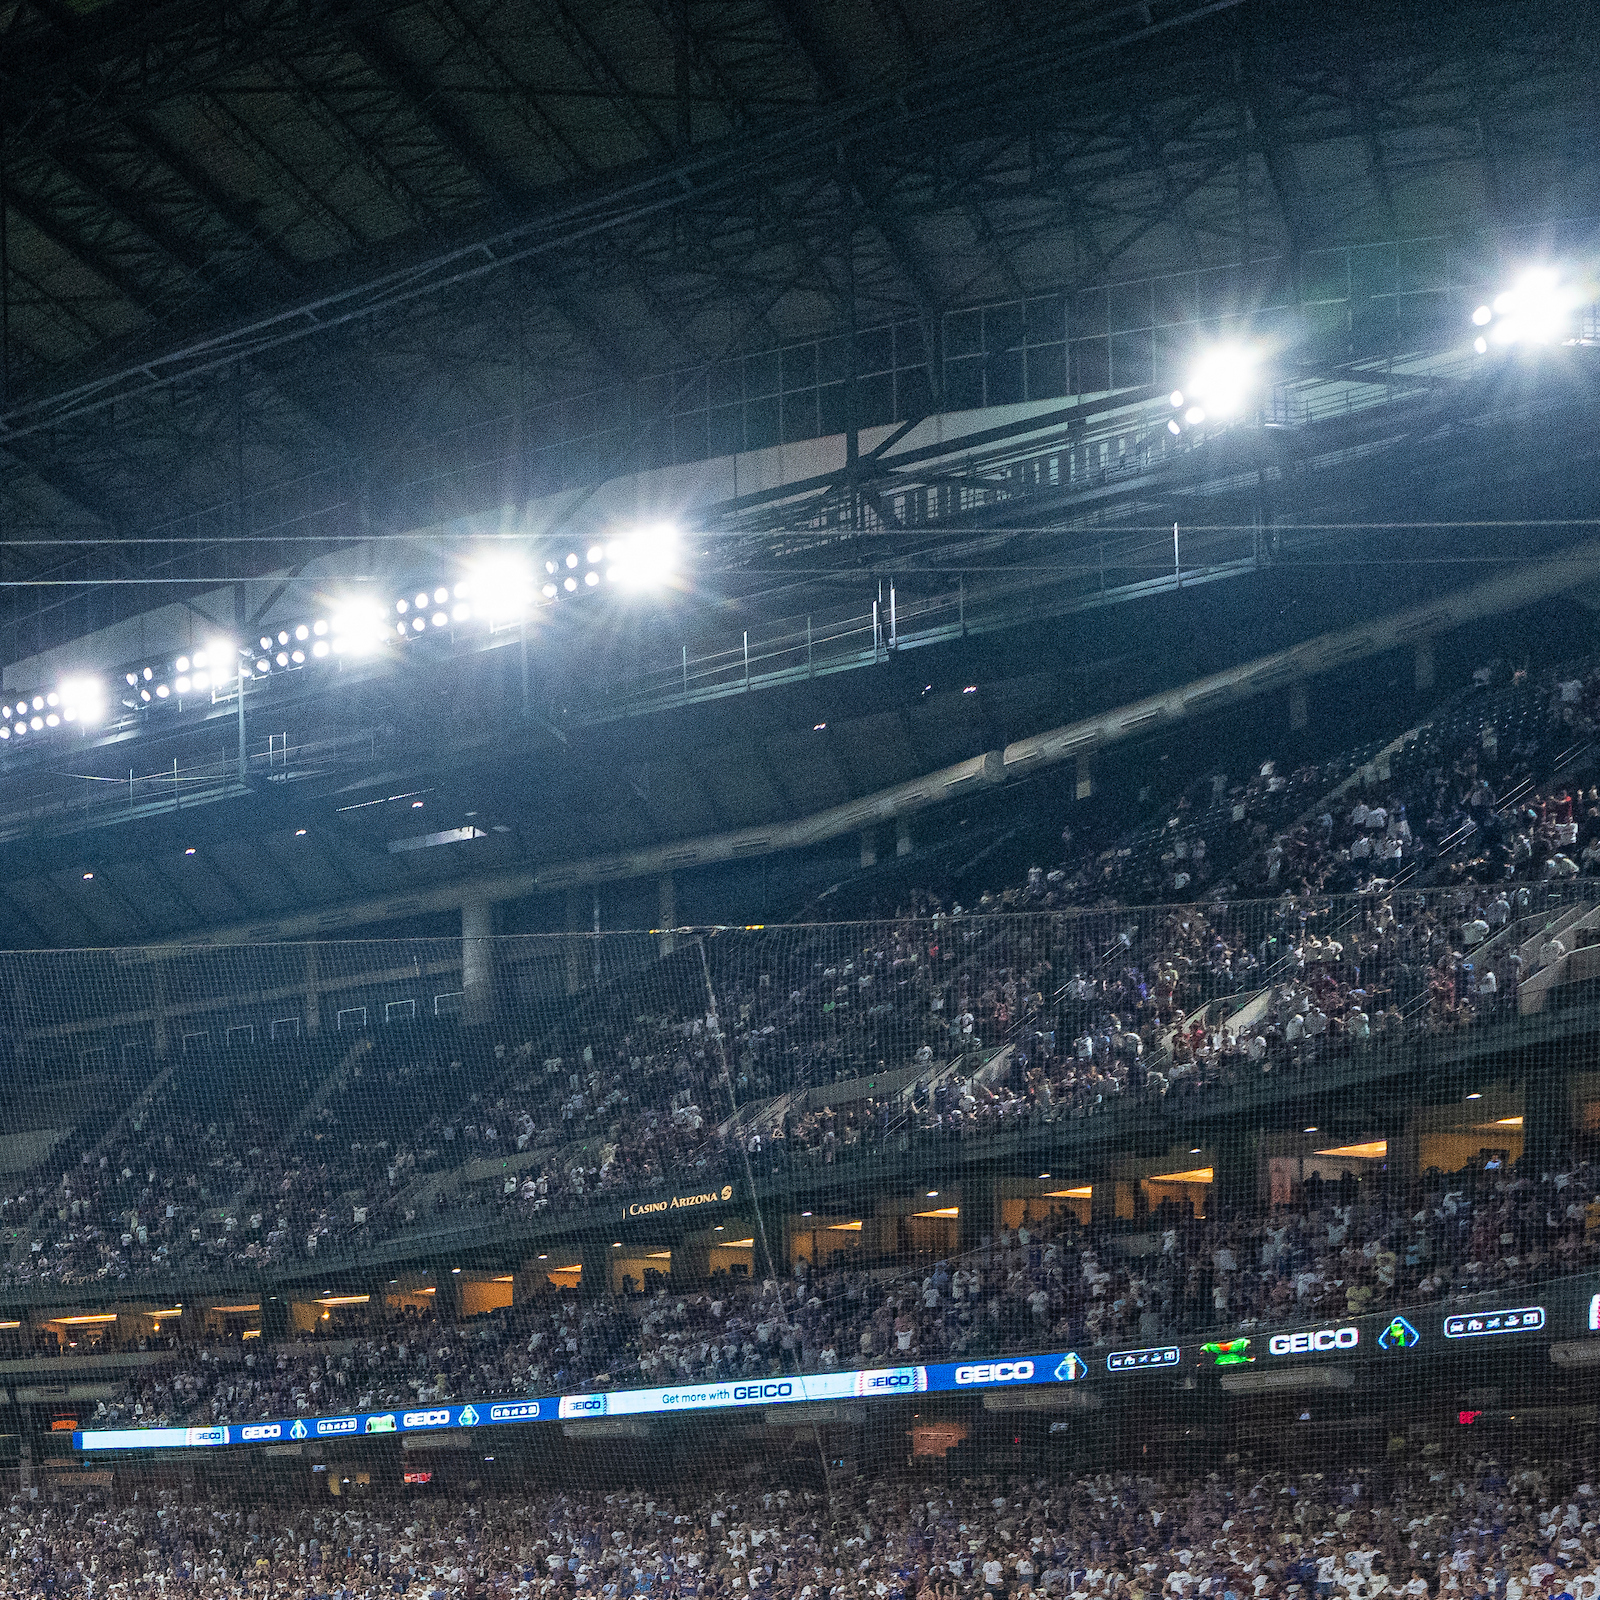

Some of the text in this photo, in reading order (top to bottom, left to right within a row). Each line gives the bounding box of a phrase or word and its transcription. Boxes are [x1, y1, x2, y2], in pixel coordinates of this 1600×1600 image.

[669, 1192, 718, 1209] ARIZONA
[1269, 1327, 1358, 1354] GEICO
[955, 1361, 1034, 1384] GEICO
[867, 1375, 910, 1388] GEICO
[662, 1383, 793, 1405] Get more with GEICO
[569, 1400, 601, 1410] GEICO
[403, 1410, 450, 1427] GEICO
[242, 1425, 281, 1440] GEICO
